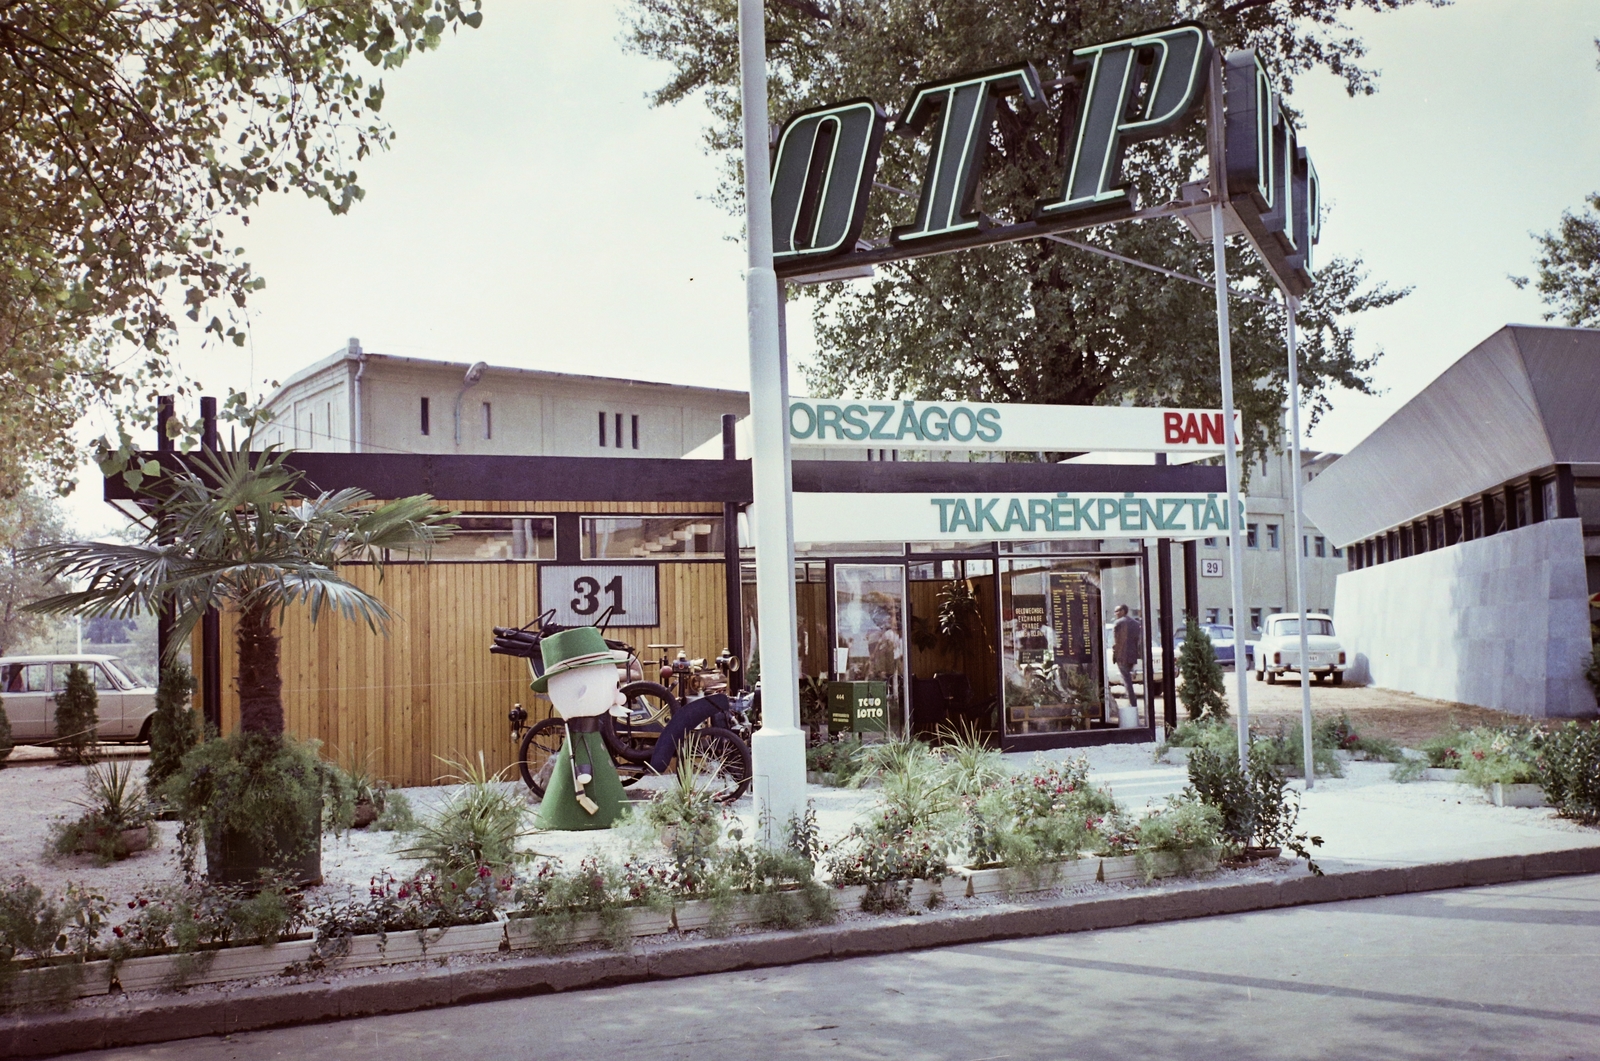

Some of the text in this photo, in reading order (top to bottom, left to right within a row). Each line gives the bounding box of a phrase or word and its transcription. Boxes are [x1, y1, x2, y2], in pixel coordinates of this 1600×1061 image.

[770, 20, 1216, 260] OTP
[789, 401, 1003, 442] ORSZÁGOS
[1163, 411, 1240, 445] BANK
[930, 492, 1246, 532] TAKARÉKPÉNZTÁR
[1206, 562, 1219, 574] 29
[571, 575, 626, 615] 31
[857, 708, 883, 718] LOTTO
[858, 697, 881, 707] TOO
